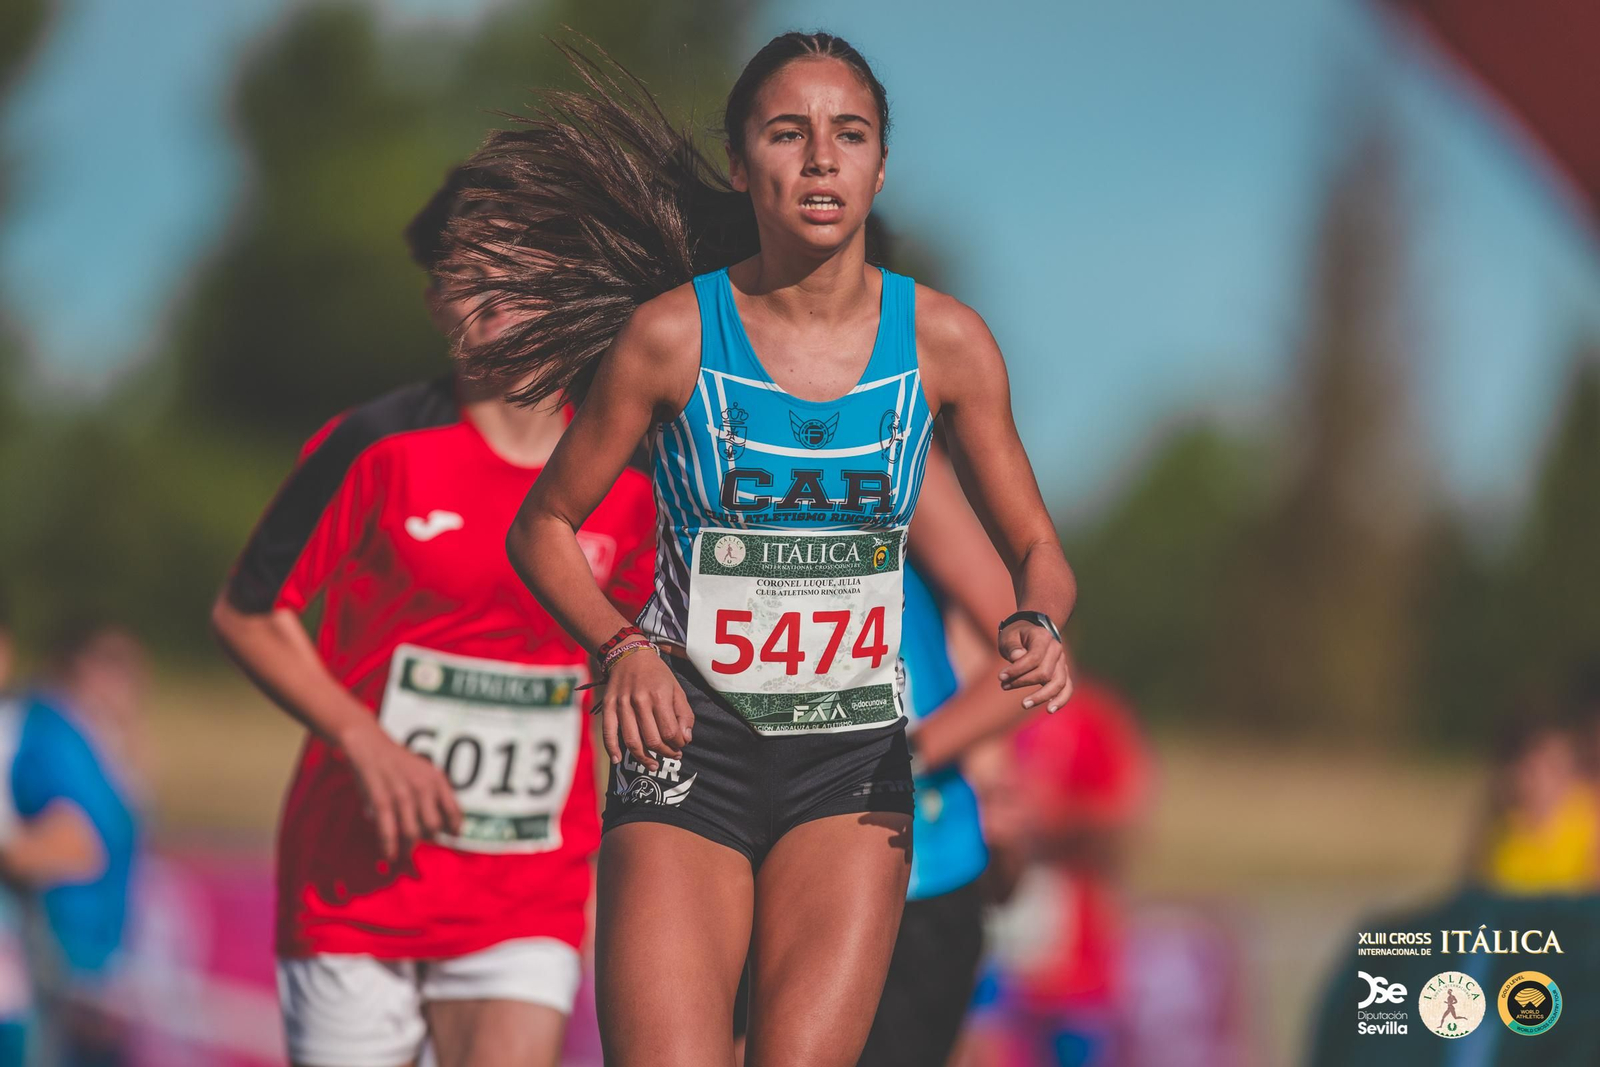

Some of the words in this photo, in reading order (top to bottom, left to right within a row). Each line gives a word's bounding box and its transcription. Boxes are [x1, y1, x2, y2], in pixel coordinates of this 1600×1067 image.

[718, 467, 896, 514] CAR
[704, 509, 739, 523] CLUB
[744, 512, 827, 523] ATLETISMO
[762, 538, 861, 564] ITÁLICA
[757, 579, 801, 588] CORONEL
[803, 579, 836, 588] LUQUE,
[837, 578, 861, 586] JULIA
[777, 588, 820, 596] ATLETISMO
[711, 606, 889, 676] 5474
[776, 724, 810, 732] ANDALUZA
[822, 720, 853, 730] ATLETISMO
